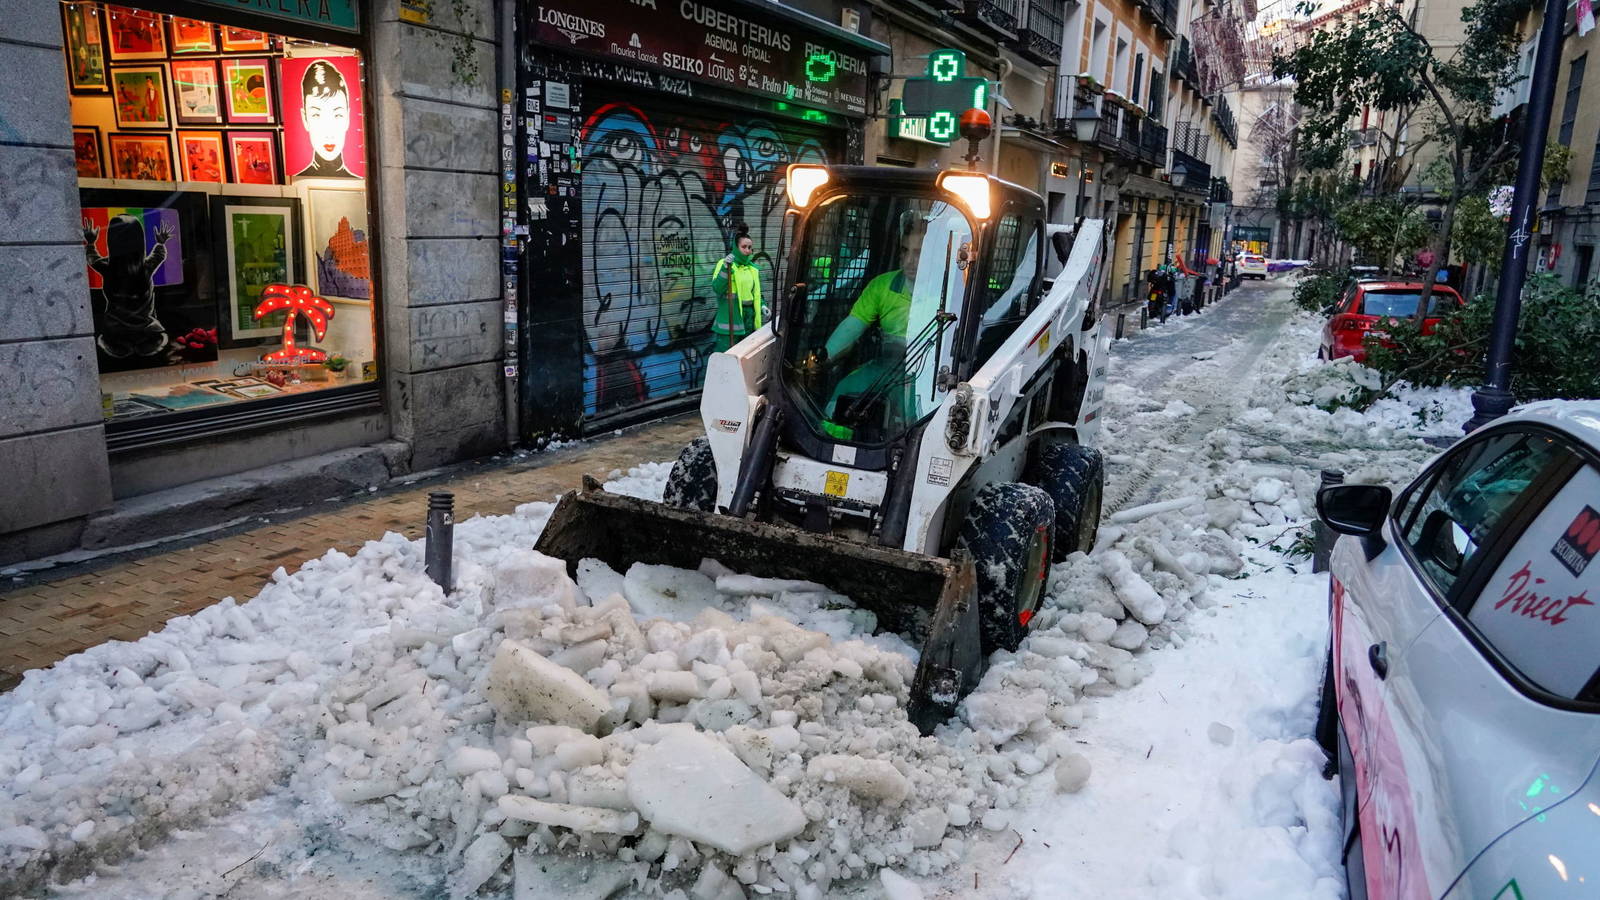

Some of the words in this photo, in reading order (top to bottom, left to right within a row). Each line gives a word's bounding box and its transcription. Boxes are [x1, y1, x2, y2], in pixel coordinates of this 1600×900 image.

[538, 6, 606, 38] LONGINES
[680, 0, 791, 52] CUBERTERIAS
[611, 42, 636, 59] Maurice
[705, 32, 738, 54] AGENCIA
[662, 52, 704, 75] SEIKO
[708, 62, 735, 83] LOTUS
[804, 42, 867, 76] RELOJERIA
[761, 75, 781, 93] Pedro
[1556, 538, 1588, 574] SECURITAS
[1494, 559, 1595, 626] Direct
